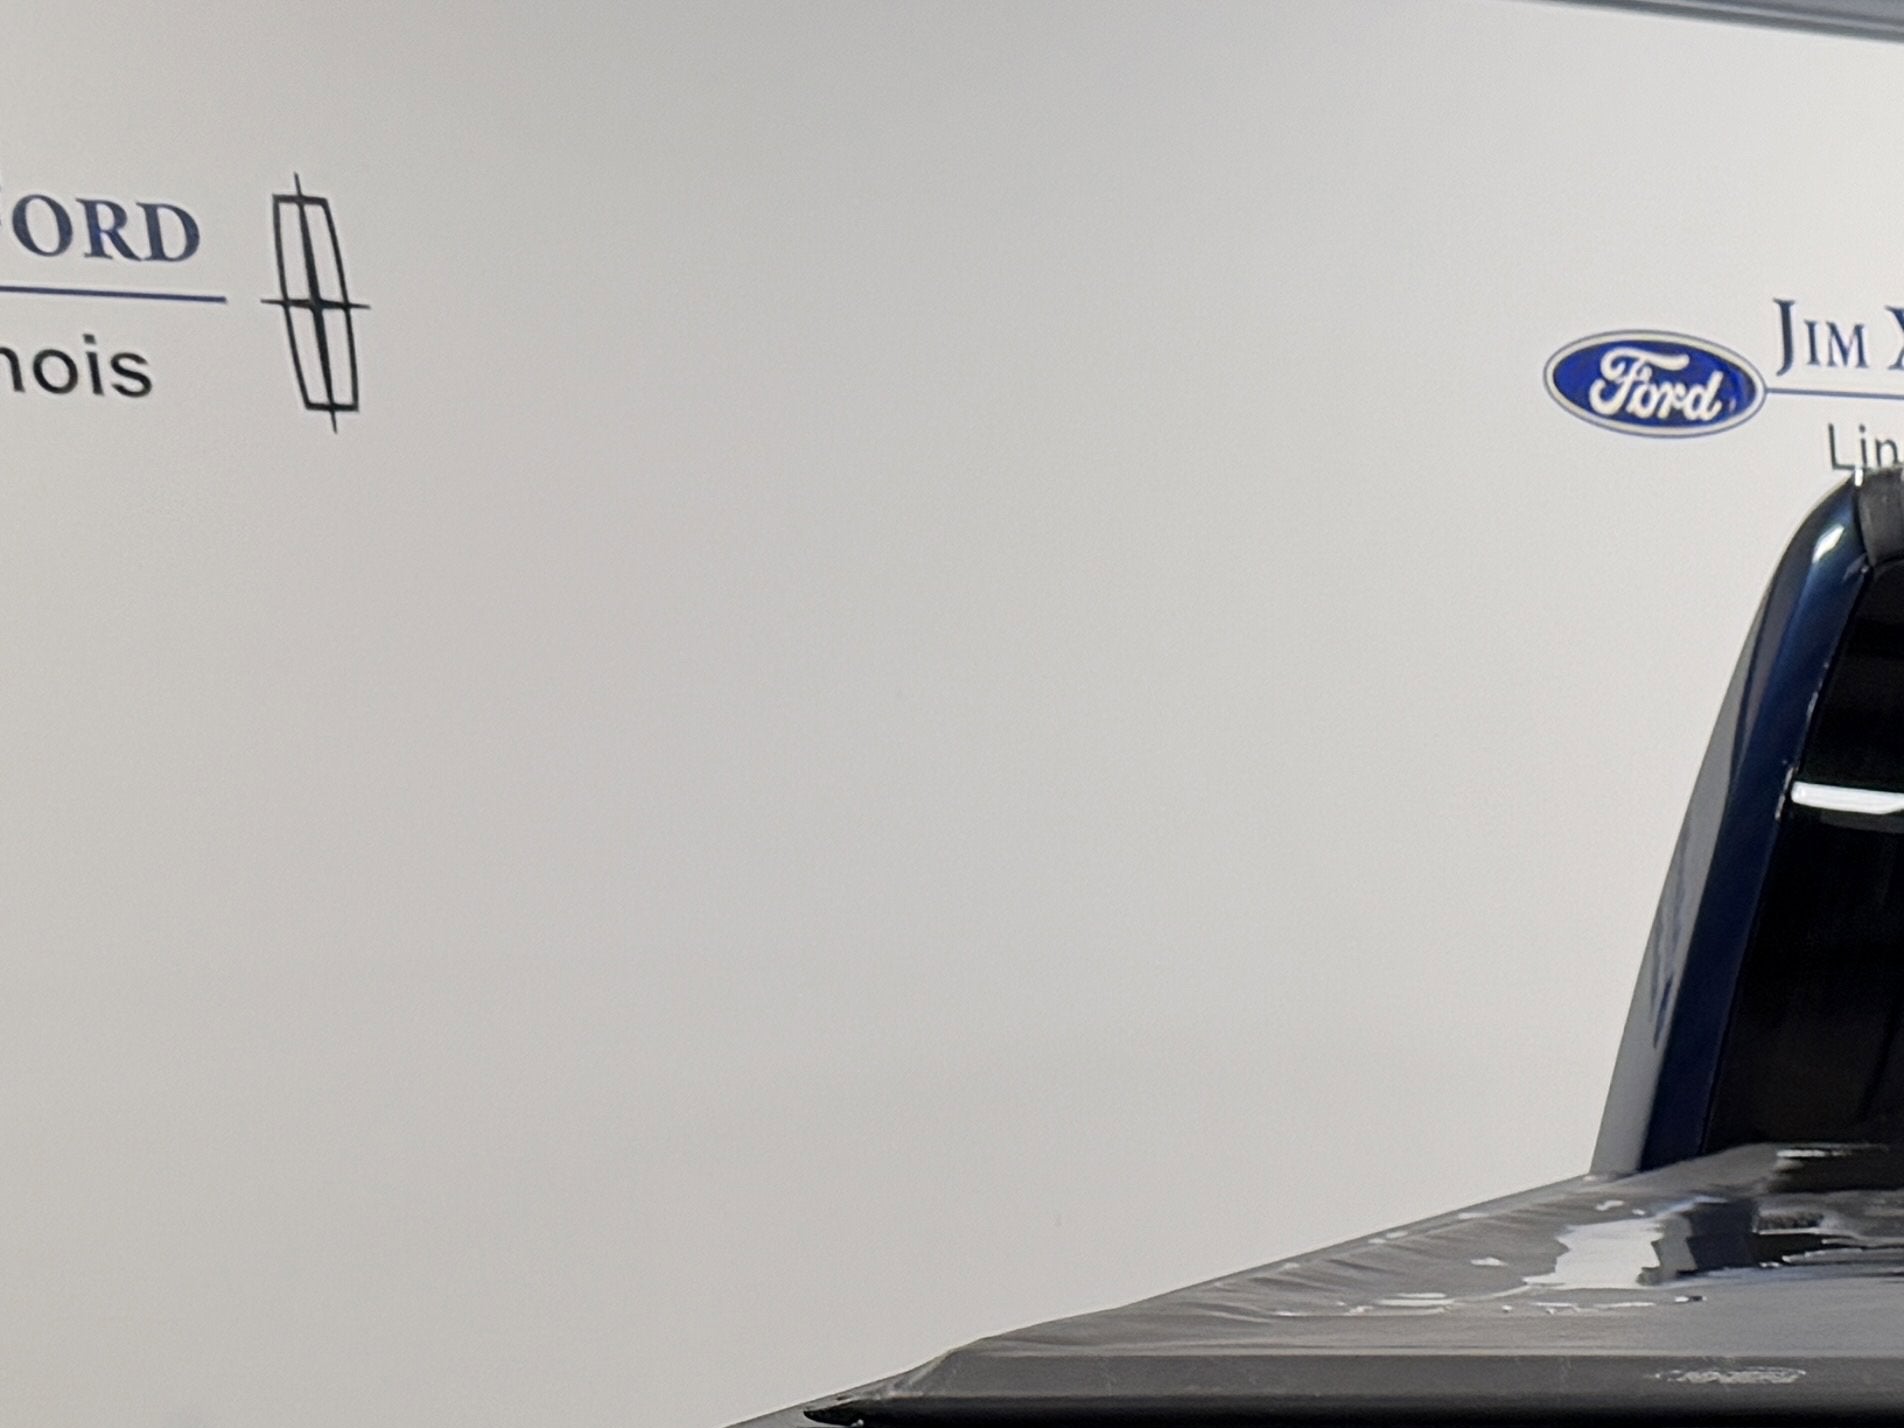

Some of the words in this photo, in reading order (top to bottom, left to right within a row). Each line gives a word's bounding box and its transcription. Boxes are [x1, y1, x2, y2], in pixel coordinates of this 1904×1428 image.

[0, 193, 201, 263] ORD
[1774, 299, 1868, 377] JIM
[1588, 345, 1724, 423] Ford
